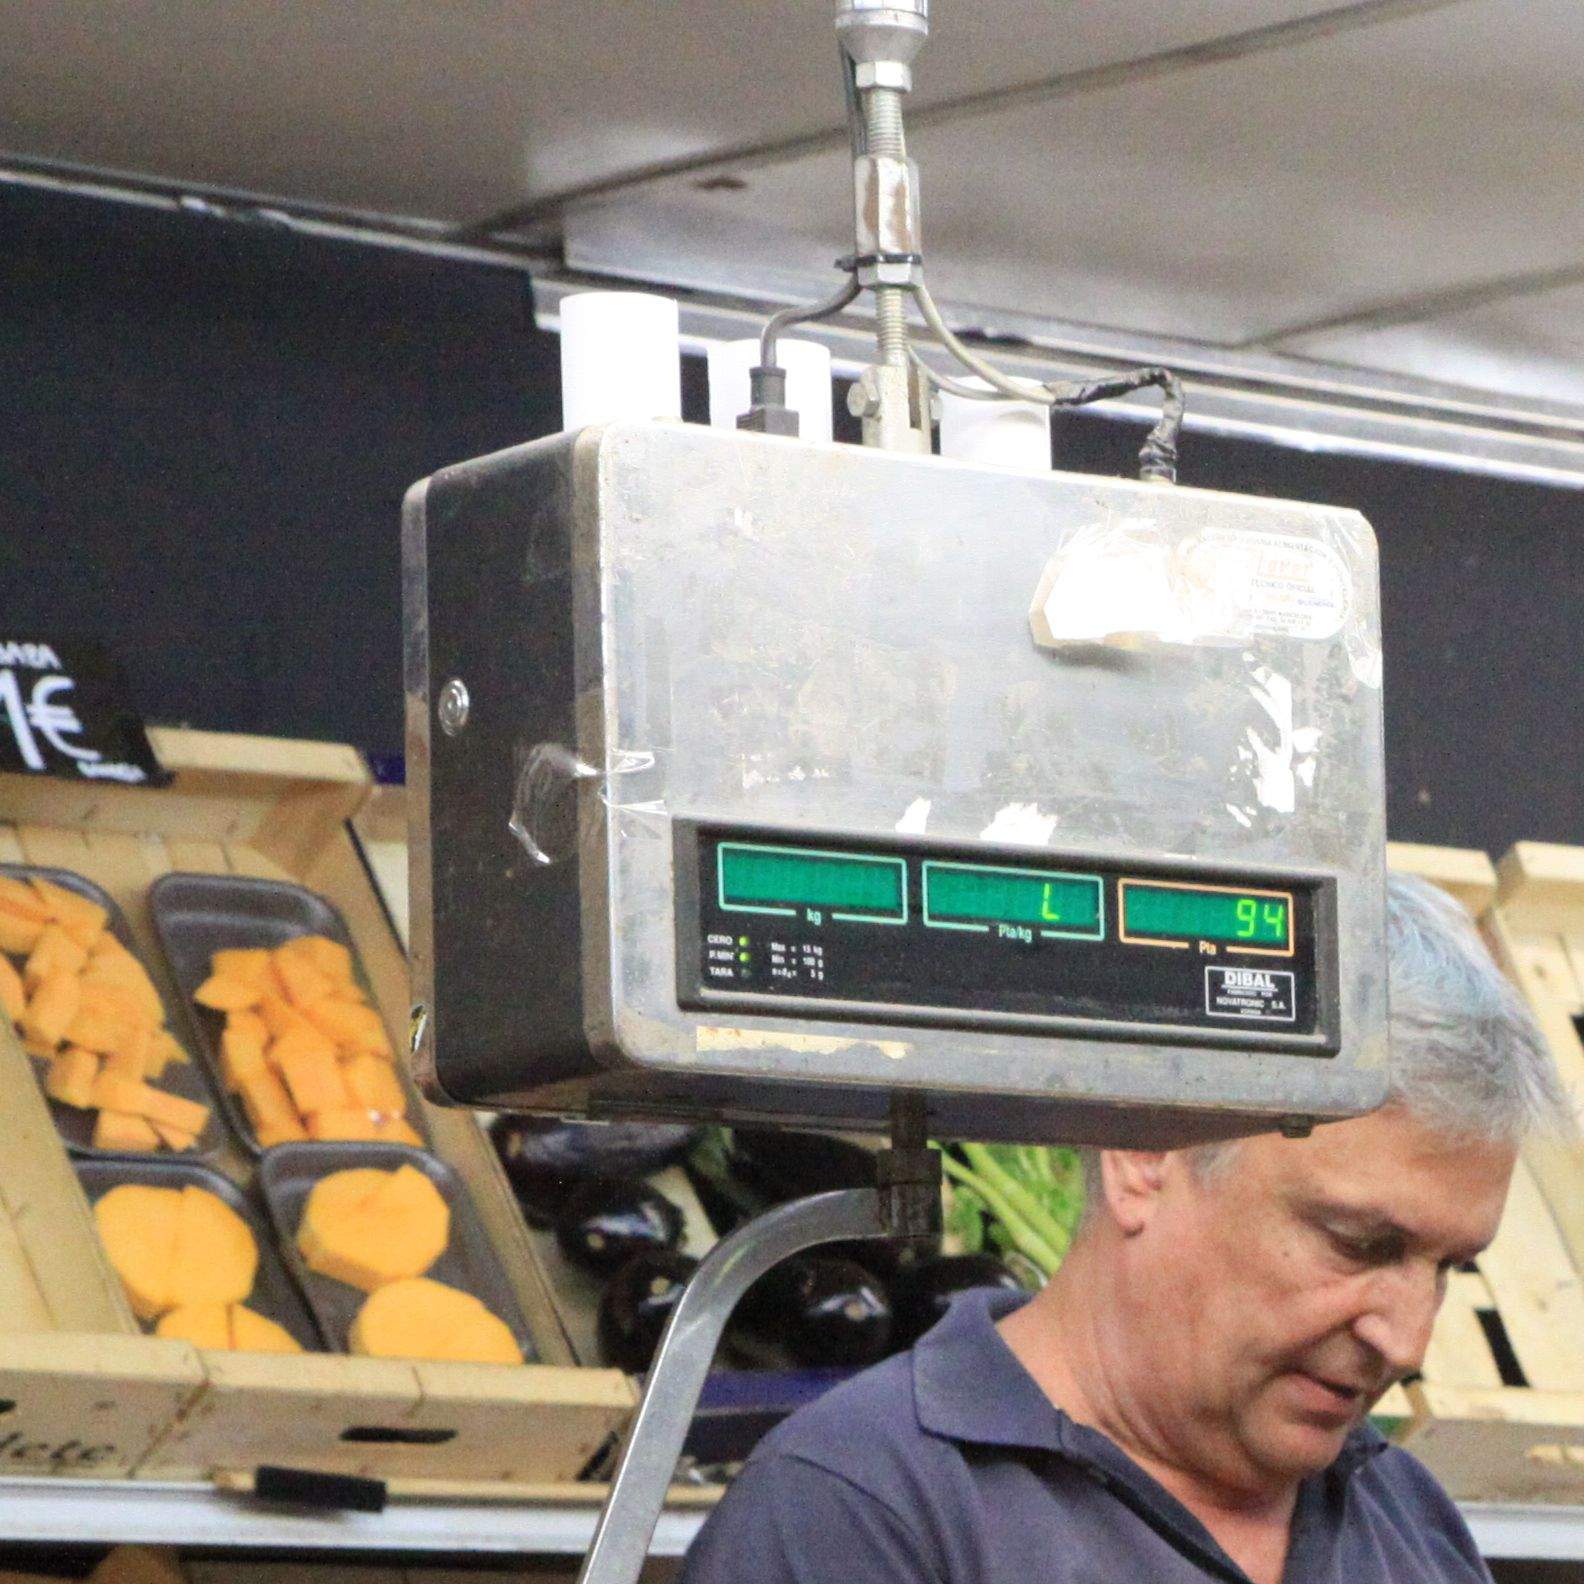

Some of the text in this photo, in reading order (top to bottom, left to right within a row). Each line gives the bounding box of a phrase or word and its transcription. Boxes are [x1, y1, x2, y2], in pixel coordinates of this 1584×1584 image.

[806, 907, 822, 926] kg
[1237, 899, 1285, 937] 94
[707, 933, 734, 946] CERO
[709, 965, 735, 978] TARA
[1224, 970, 1276, 989] DIBAL
